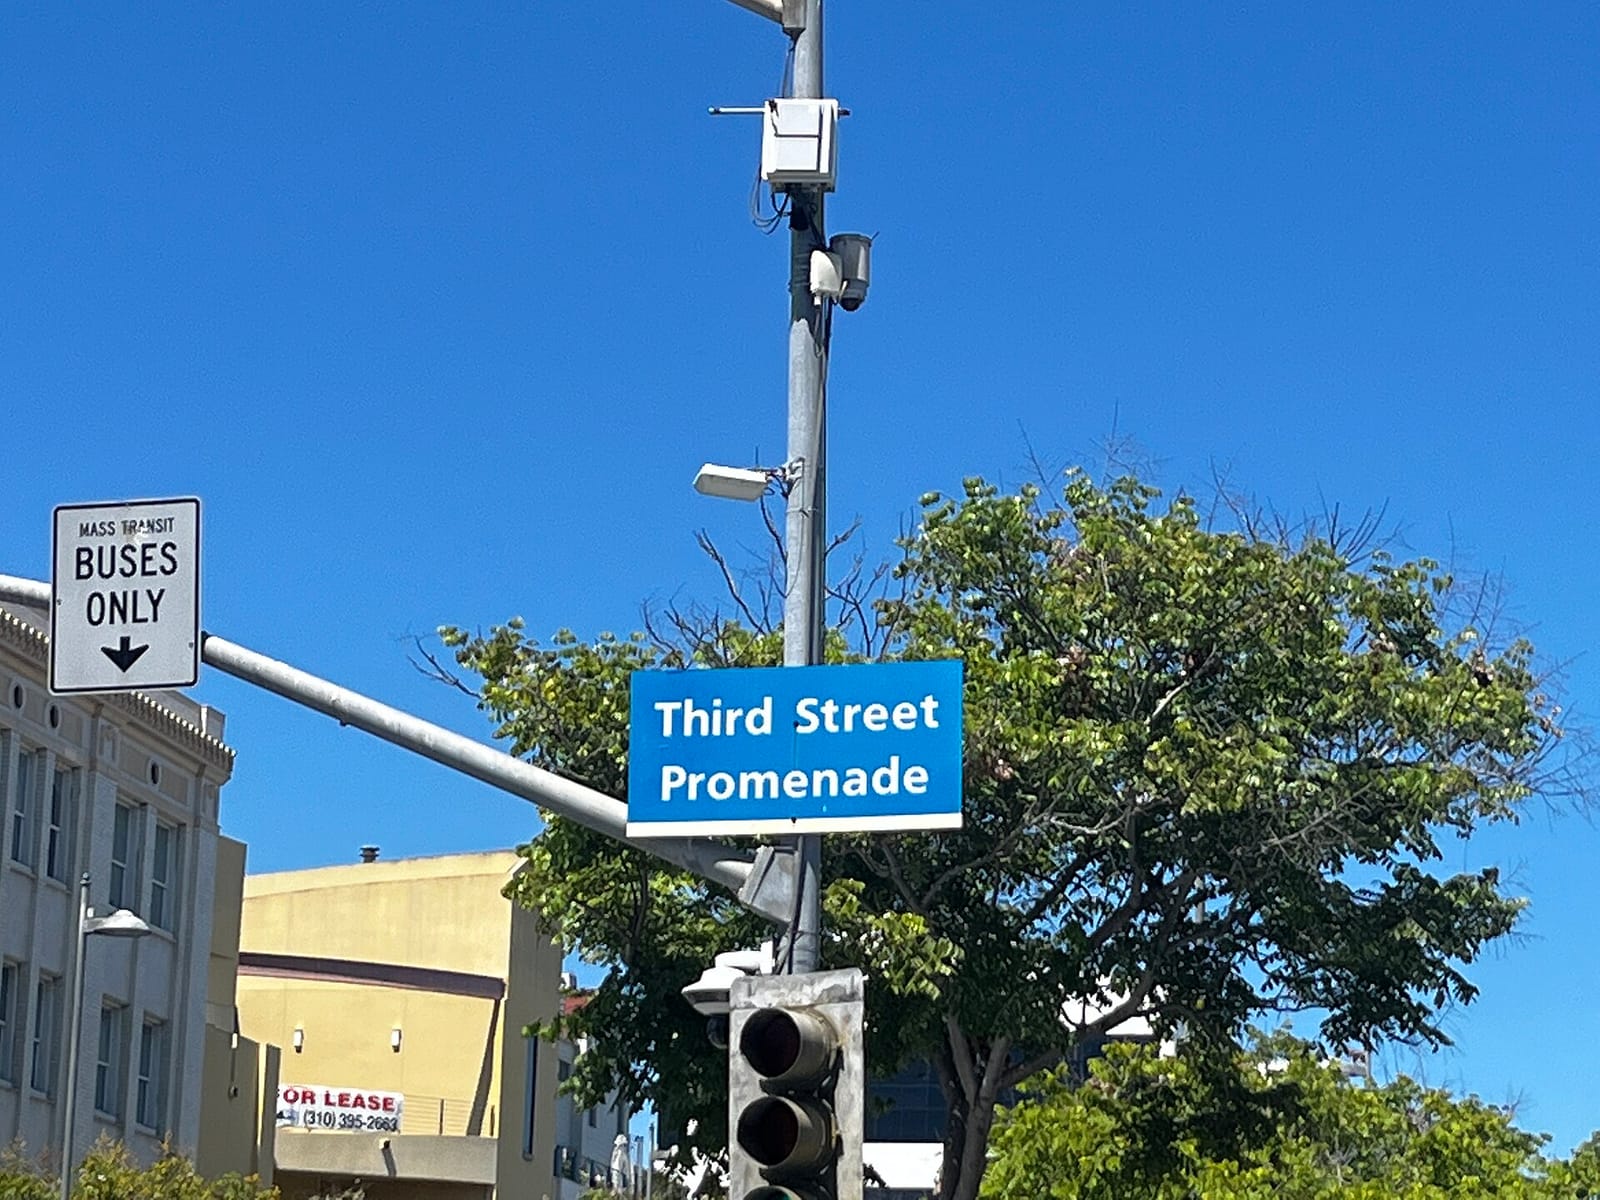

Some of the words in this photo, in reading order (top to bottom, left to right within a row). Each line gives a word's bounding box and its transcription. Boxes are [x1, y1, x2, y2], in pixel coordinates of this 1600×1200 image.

[79, 521, 116, 537] MASS
[121, 517, 175, 535] TRANSIT
[75, 541, 178, 580] BUSES
[86, 588, 166, 626] ONLY
[654, 696, 773, 738] Third
[796, 694, 940, 735] Street
[660, 755, 930, 802] Promenade
[277, 1088, 316, 1105] OR
[324, 1090, 396, 1112] LEASE
[303, 1109, 337, 1129] (310)
